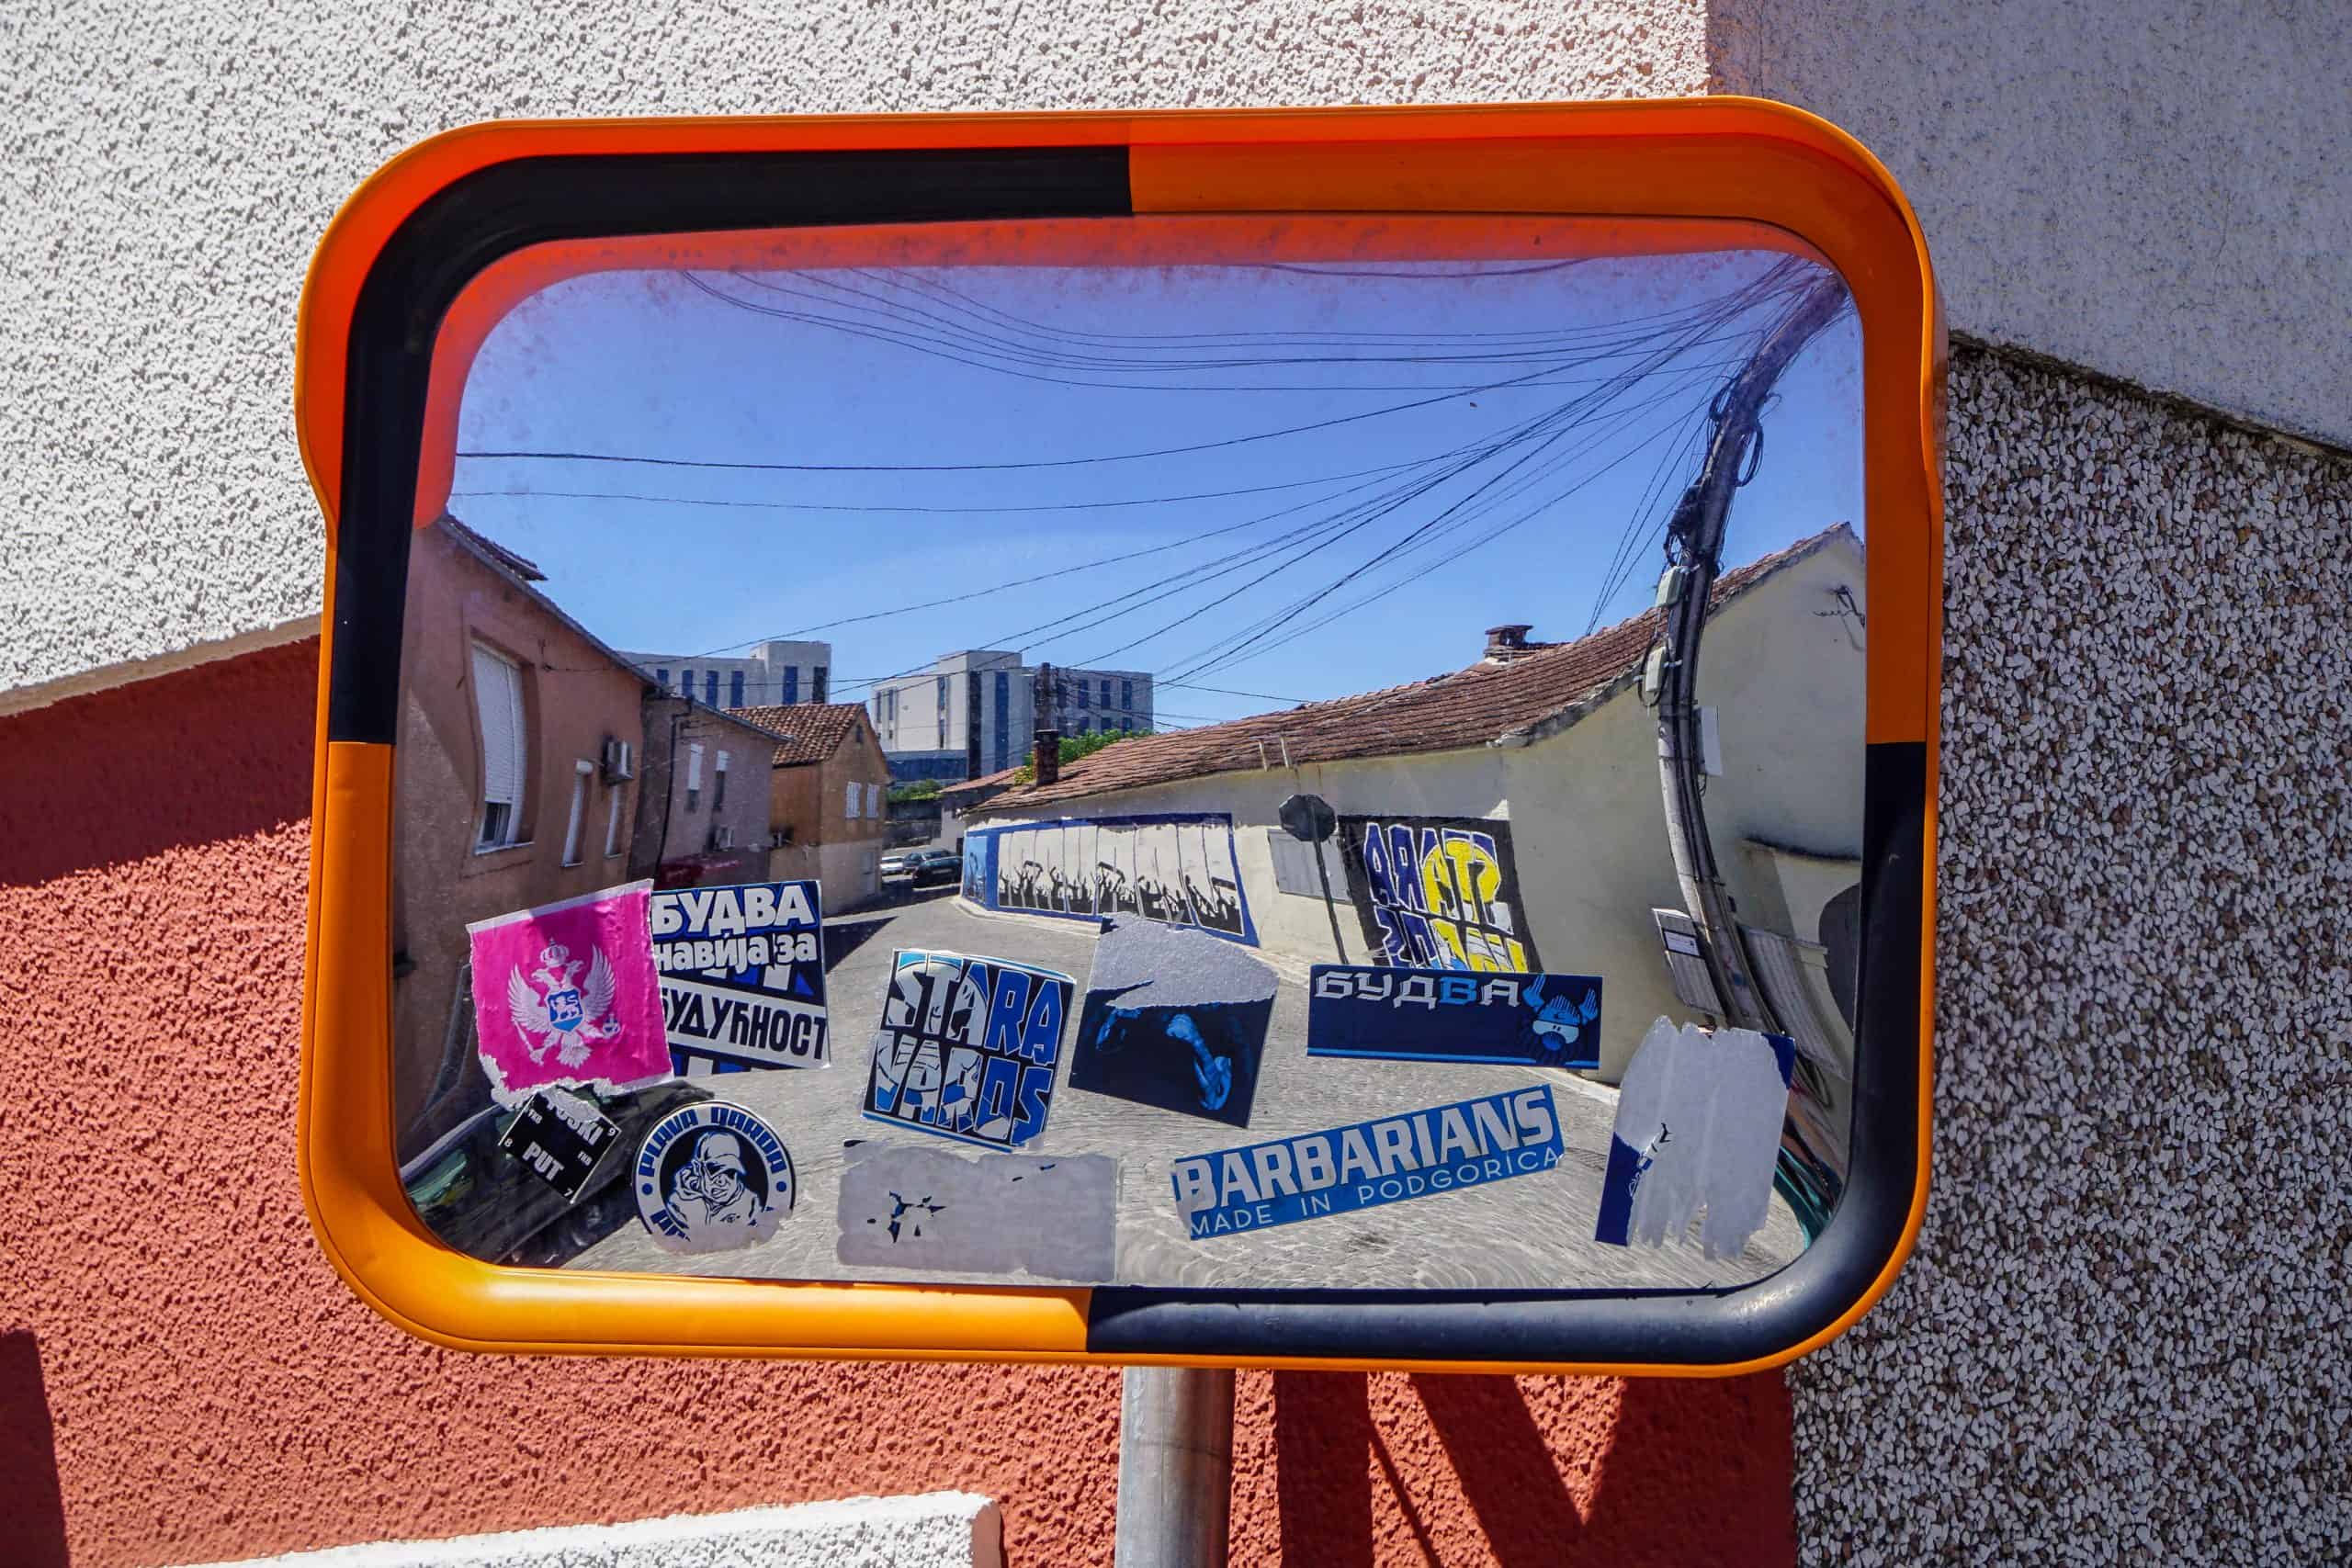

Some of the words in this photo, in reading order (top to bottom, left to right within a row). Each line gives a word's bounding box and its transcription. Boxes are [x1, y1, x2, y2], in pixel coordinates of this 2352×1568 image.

[651, 885, 816, 938] БУДВА
[654, 933, 770, 975] навија
[776, 932, 818, 964] за
[886, 952, 1063, 1066] STARA
[1315, 970, 1521, 1010] БУДВА
[875, 1029, 1055, 1146] VAROS
[522, 1141, 565, 1181] PUT
[638, 1108, 699, 1178] PLAVA
[1176, 1089, 1554, 1213] BARBARIANS
[1192, 1204, 1274, 1235] MADE
[1300, 1192, 1331, 1216] IN
[1357, 1146, 1559, 1205] PODGORICA
